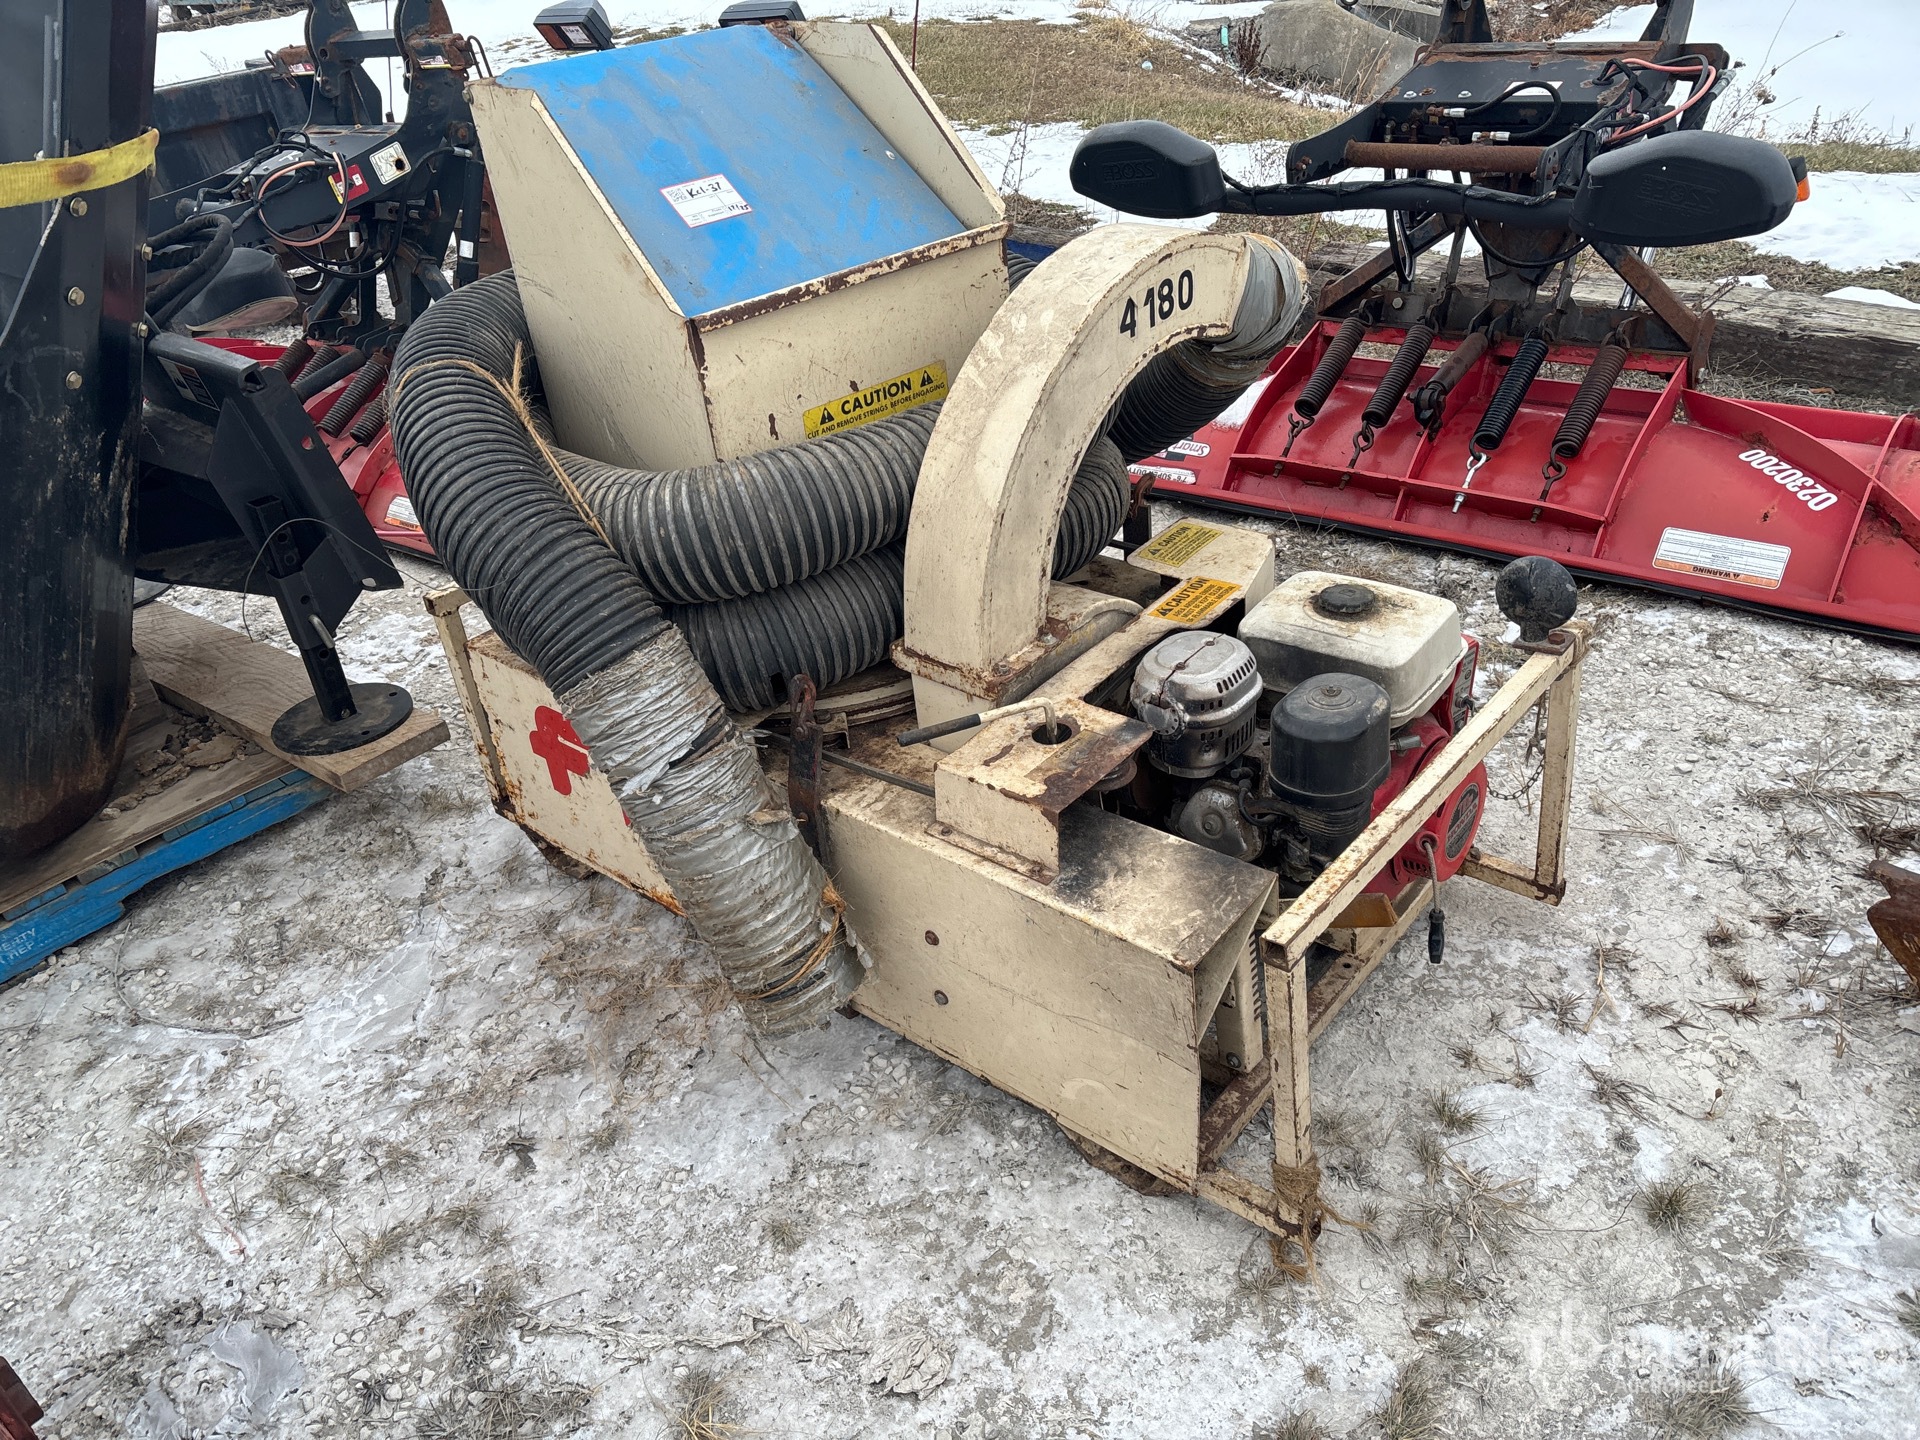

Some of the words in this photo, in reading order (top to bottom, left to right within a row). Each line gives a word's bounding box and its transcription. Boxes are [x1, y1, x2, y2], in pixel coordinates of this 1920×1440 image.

[807, 430, 820, 440] CUT
[821, 425, 836, 435] AND
[836, 415, 863, 429] REMOVE
[863, 405, 889, 419] STRINGS
[890, 395, 912, 409] BEFORE
[912, 382, 945, 400] ENGAGING
[840, 377, 912, 415] CAUTION
[1738, 449, 1838, 512] 0230200
[1158, 526, 1191, 547] CAUTION
[1692, 566, 1731, 578] WARNING
[1165, 577, 1211, 608] CAUTION
